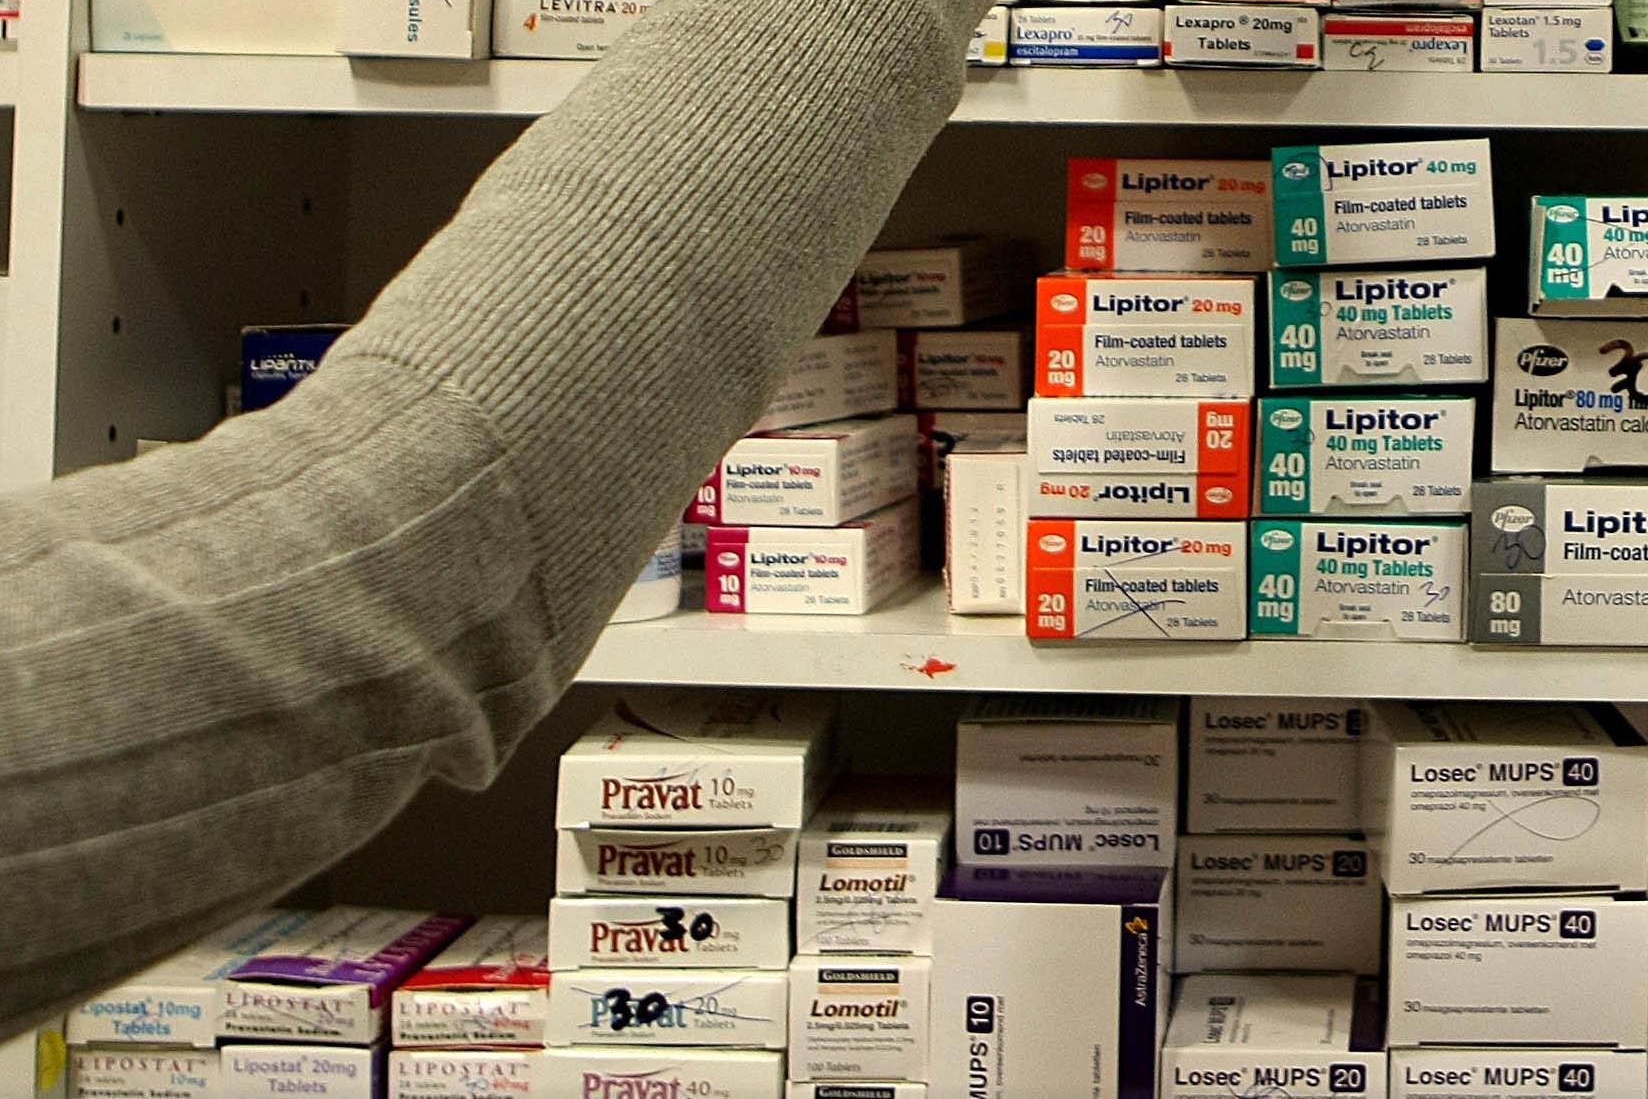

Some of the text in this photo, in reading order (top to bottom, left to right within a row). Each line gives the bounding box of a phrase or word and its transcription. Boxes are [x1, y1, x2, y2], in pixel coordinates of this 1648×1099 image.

[1176, 17, 1292, 33] Lexapro 20mg
[1198, 37, 1251, 51] Tablets
[1335, 279, 1446, 301] Lipitor
[1093, 294, 1242, 315] Lipitor 20 mg
[1337, 305, 1452, 324] 40 mg Tablets
[1337, 324, 1431, 340] Atorvastatin
[1094, 335, 1227, 348] Film-coated tablets
[1095, 355, 1175, 367] Atorvastatin
[1519, 351, 1565, 370] Pfizer
[1576, 391, 1595, 409] 80
[1599, 394, 1623, 412] mg
[1515, 414, 1615, 432] Atorvastatin
[1411, 764, 1594, 782] Losec MUPS 40
[602, 777, 734, 810] Pravat 10
[709, 799, 753, 810] Tablets
[830, 845, 904, 857] GOLDSHIELD
[819, 874, 907, 892] Lomotil
[1407, 914, 1591, 934] Losec MUPS 40
[1135, 933, 1148, 1006] AstraZeneca
[811, 1000, 899, 1018] Lomotil
[311, 1061, 357, 1078] 20mg
[1175, 1067, 1361, 1087] Losec MUPS 20
[269, 1079, 327, 1094] Tablets
